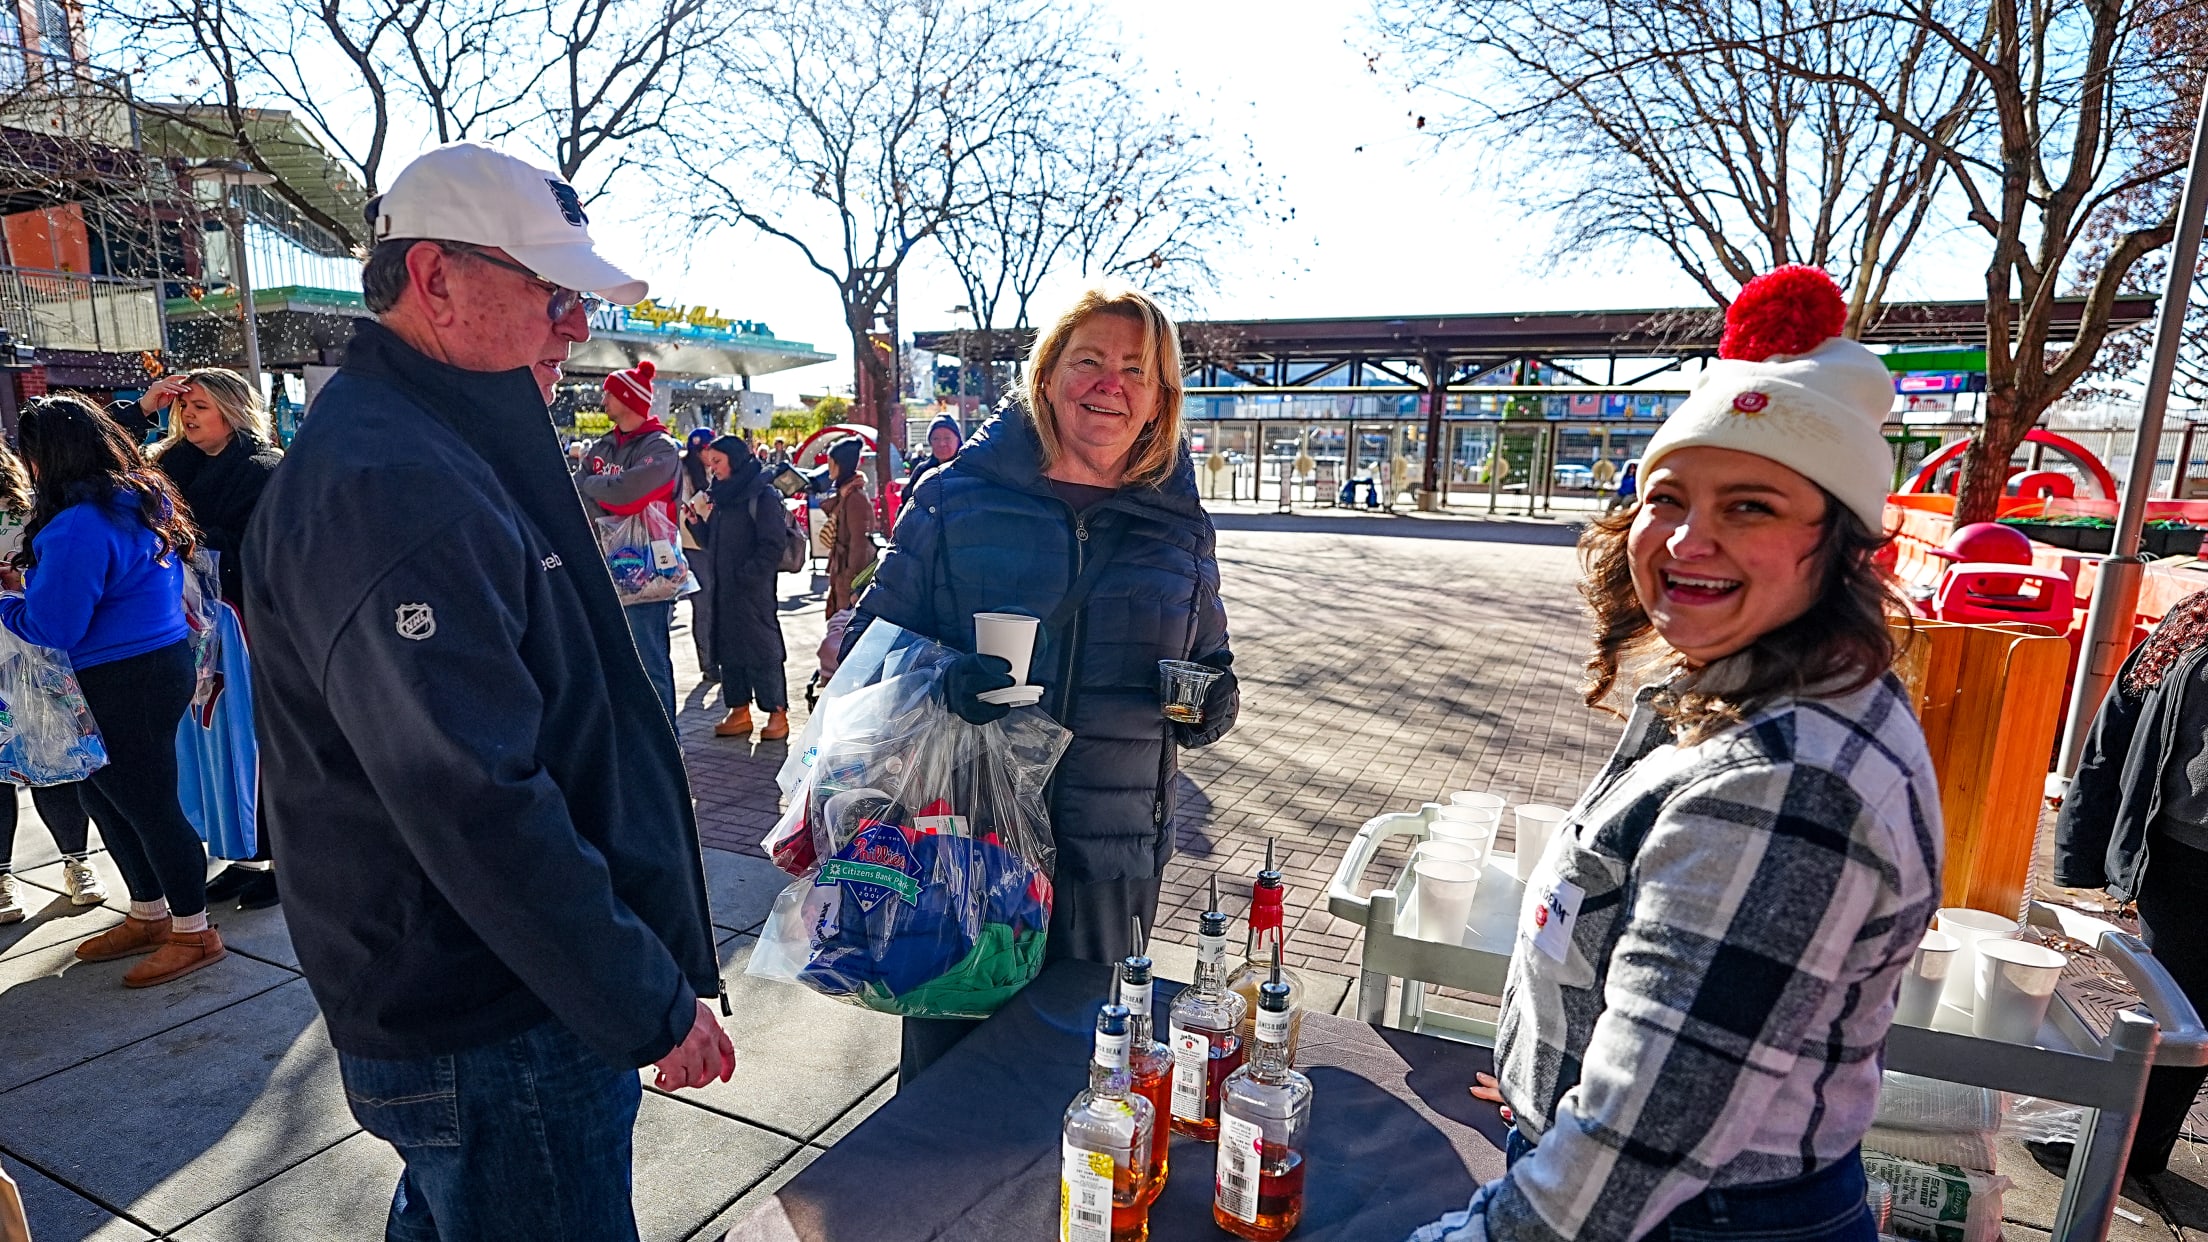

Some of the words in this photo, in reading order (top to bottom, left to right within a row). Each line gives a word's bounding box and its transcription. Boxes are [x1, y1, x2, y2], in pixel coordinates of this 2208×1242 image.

[405, 612, 428, 633] NHL
[851, 837, 907, 869] Phillies
[842, 866, 874, 878] Citizens
[875, 871, 892, 882] Bank
[894, 877, 909, 890] Park
[1928, 1177, 1941, 1208] SOLO
